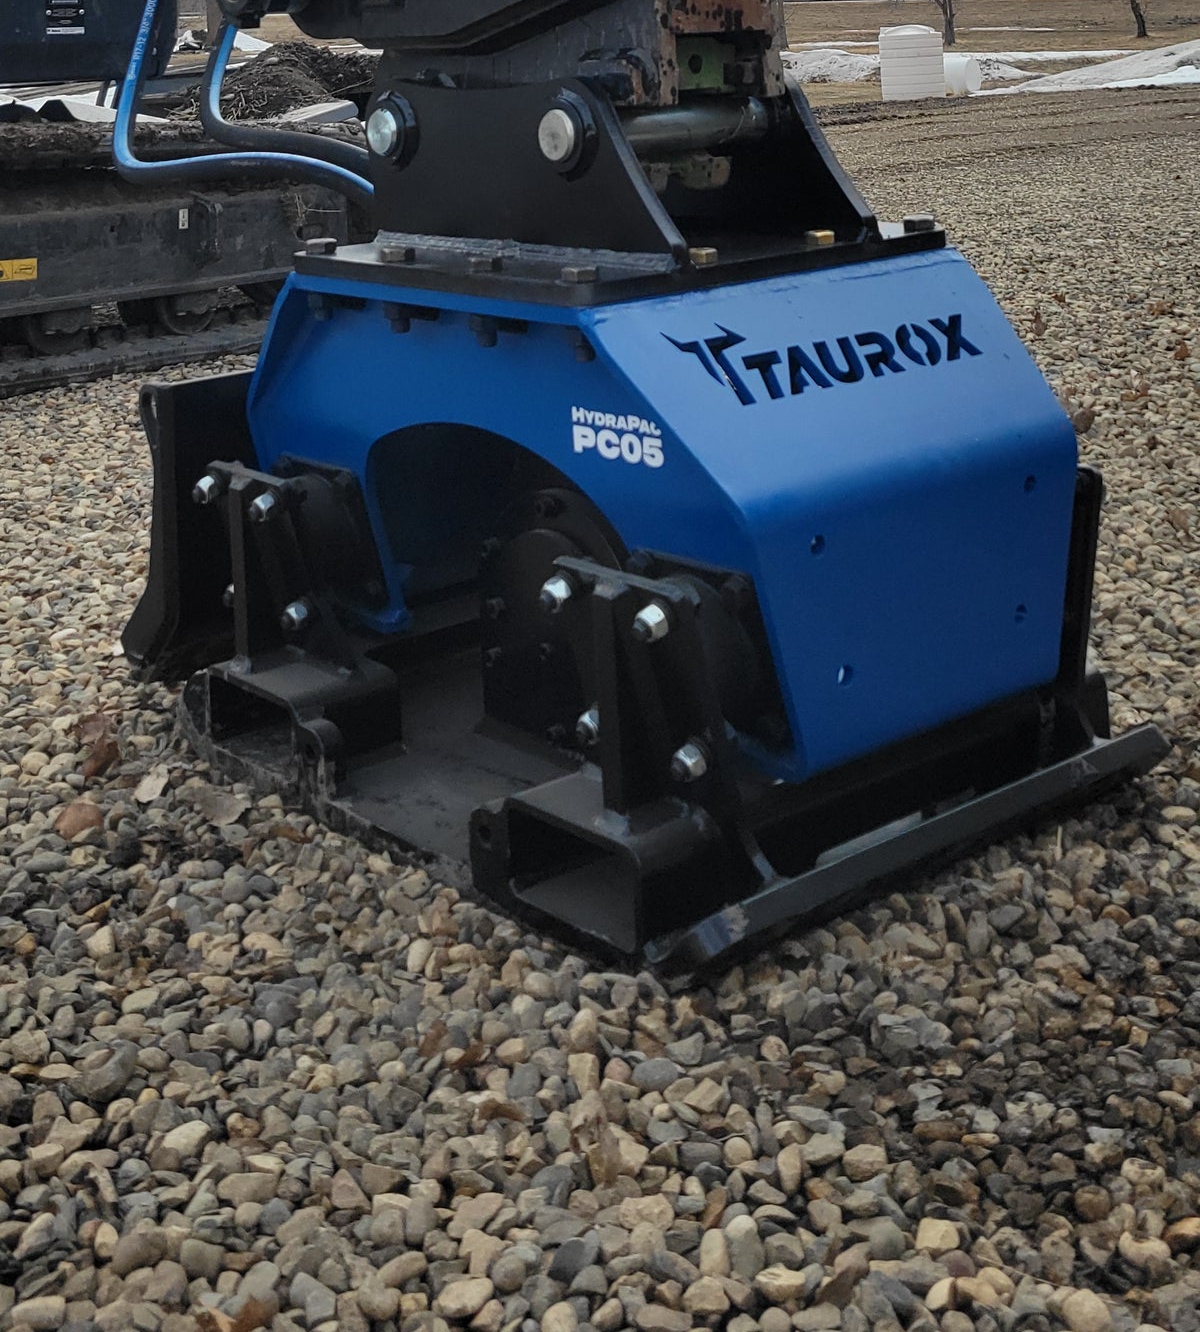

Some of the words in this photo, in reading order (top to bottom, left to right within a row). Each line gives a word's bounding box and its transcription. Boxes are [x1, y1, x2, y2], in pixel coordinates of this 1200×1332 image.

[133, 36, 147, 60] R17-12
[741, 313, 984, 400] TAUROX
[572, 423, 665, 469] PC05
